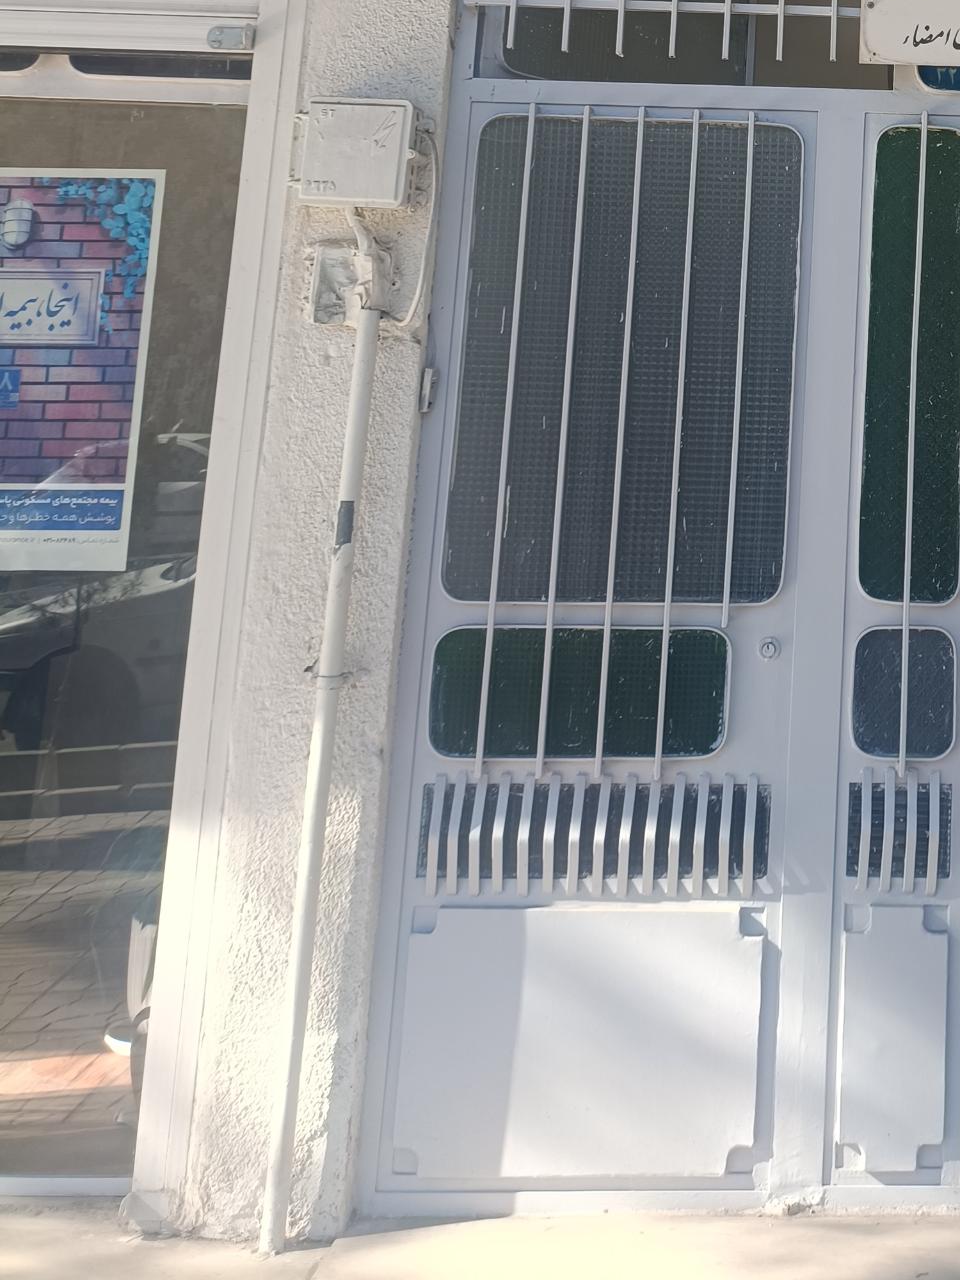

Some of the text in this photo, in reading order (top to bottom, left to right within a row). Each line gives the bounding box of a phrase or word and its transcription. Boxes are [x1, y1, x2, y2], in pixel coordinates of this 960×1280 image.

[902, 23, 952, 48] امضاء
[3, 296, 39, 331] بیمه
[12, 495, 51, 507] مسکونی
[99, 496, 118, 507] بیمه
